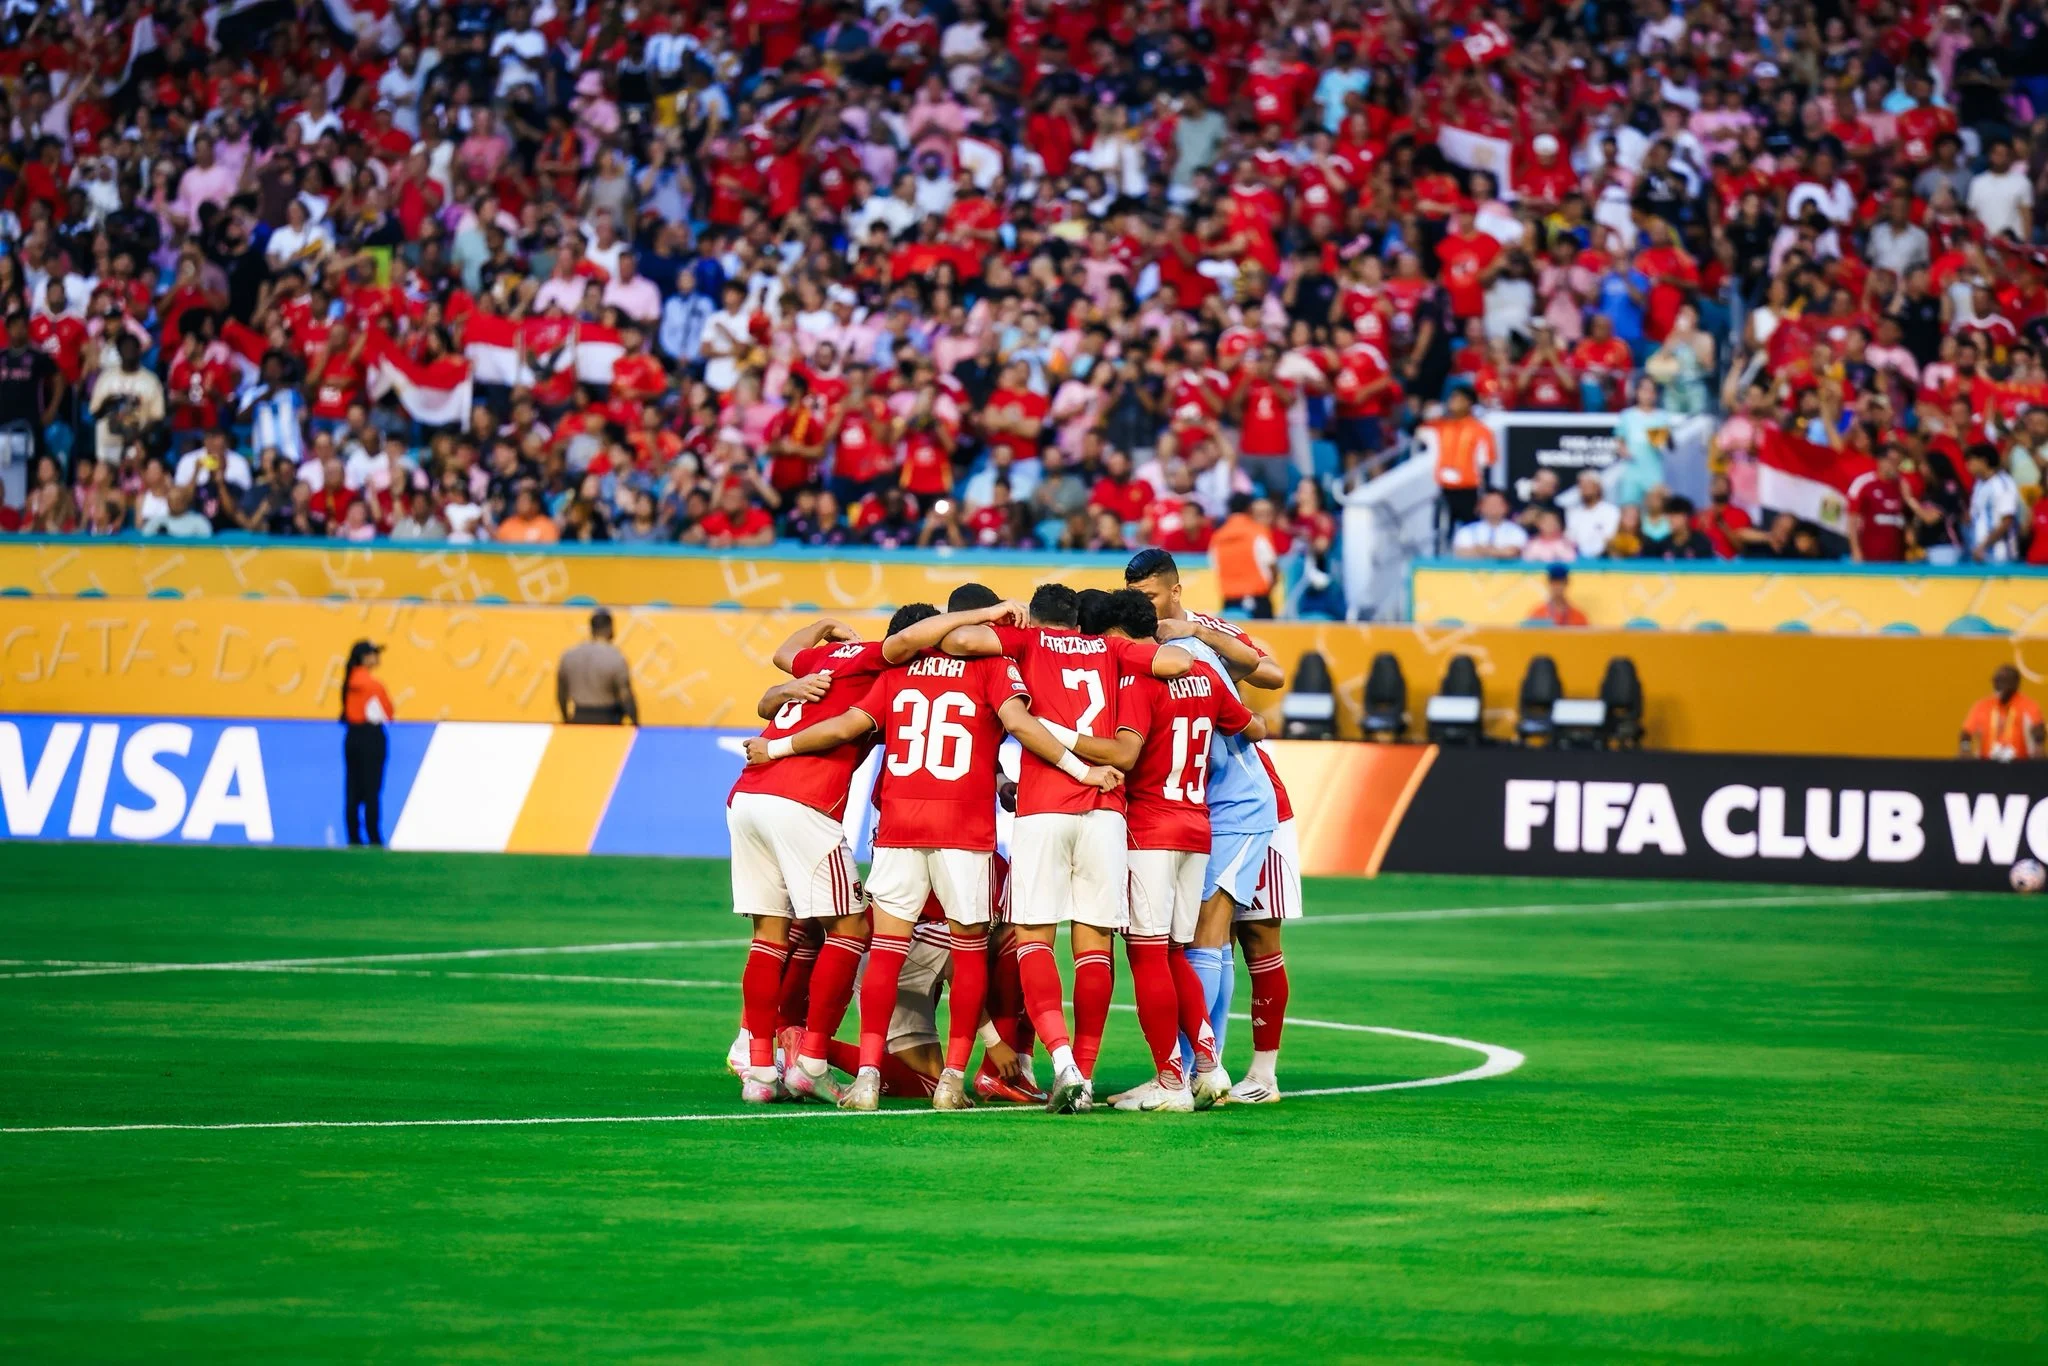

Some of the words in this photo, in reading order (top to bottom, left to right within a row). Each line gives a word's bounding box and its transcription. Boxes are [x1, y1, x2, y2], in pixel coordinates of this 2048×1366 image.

[907, 656, 966, 678] A.KOKA
[1061, 668, 1106, 737] 7
[887, 688, 977, 781] 36
[1162, 716, 1213, 805] 13
[0, 721, 274, 842] VISA
[1504, 779, 1687, 855] FIFA
[1701, 784, 1925, 862] CLUB
[1943, 792, 2048, 865] W
